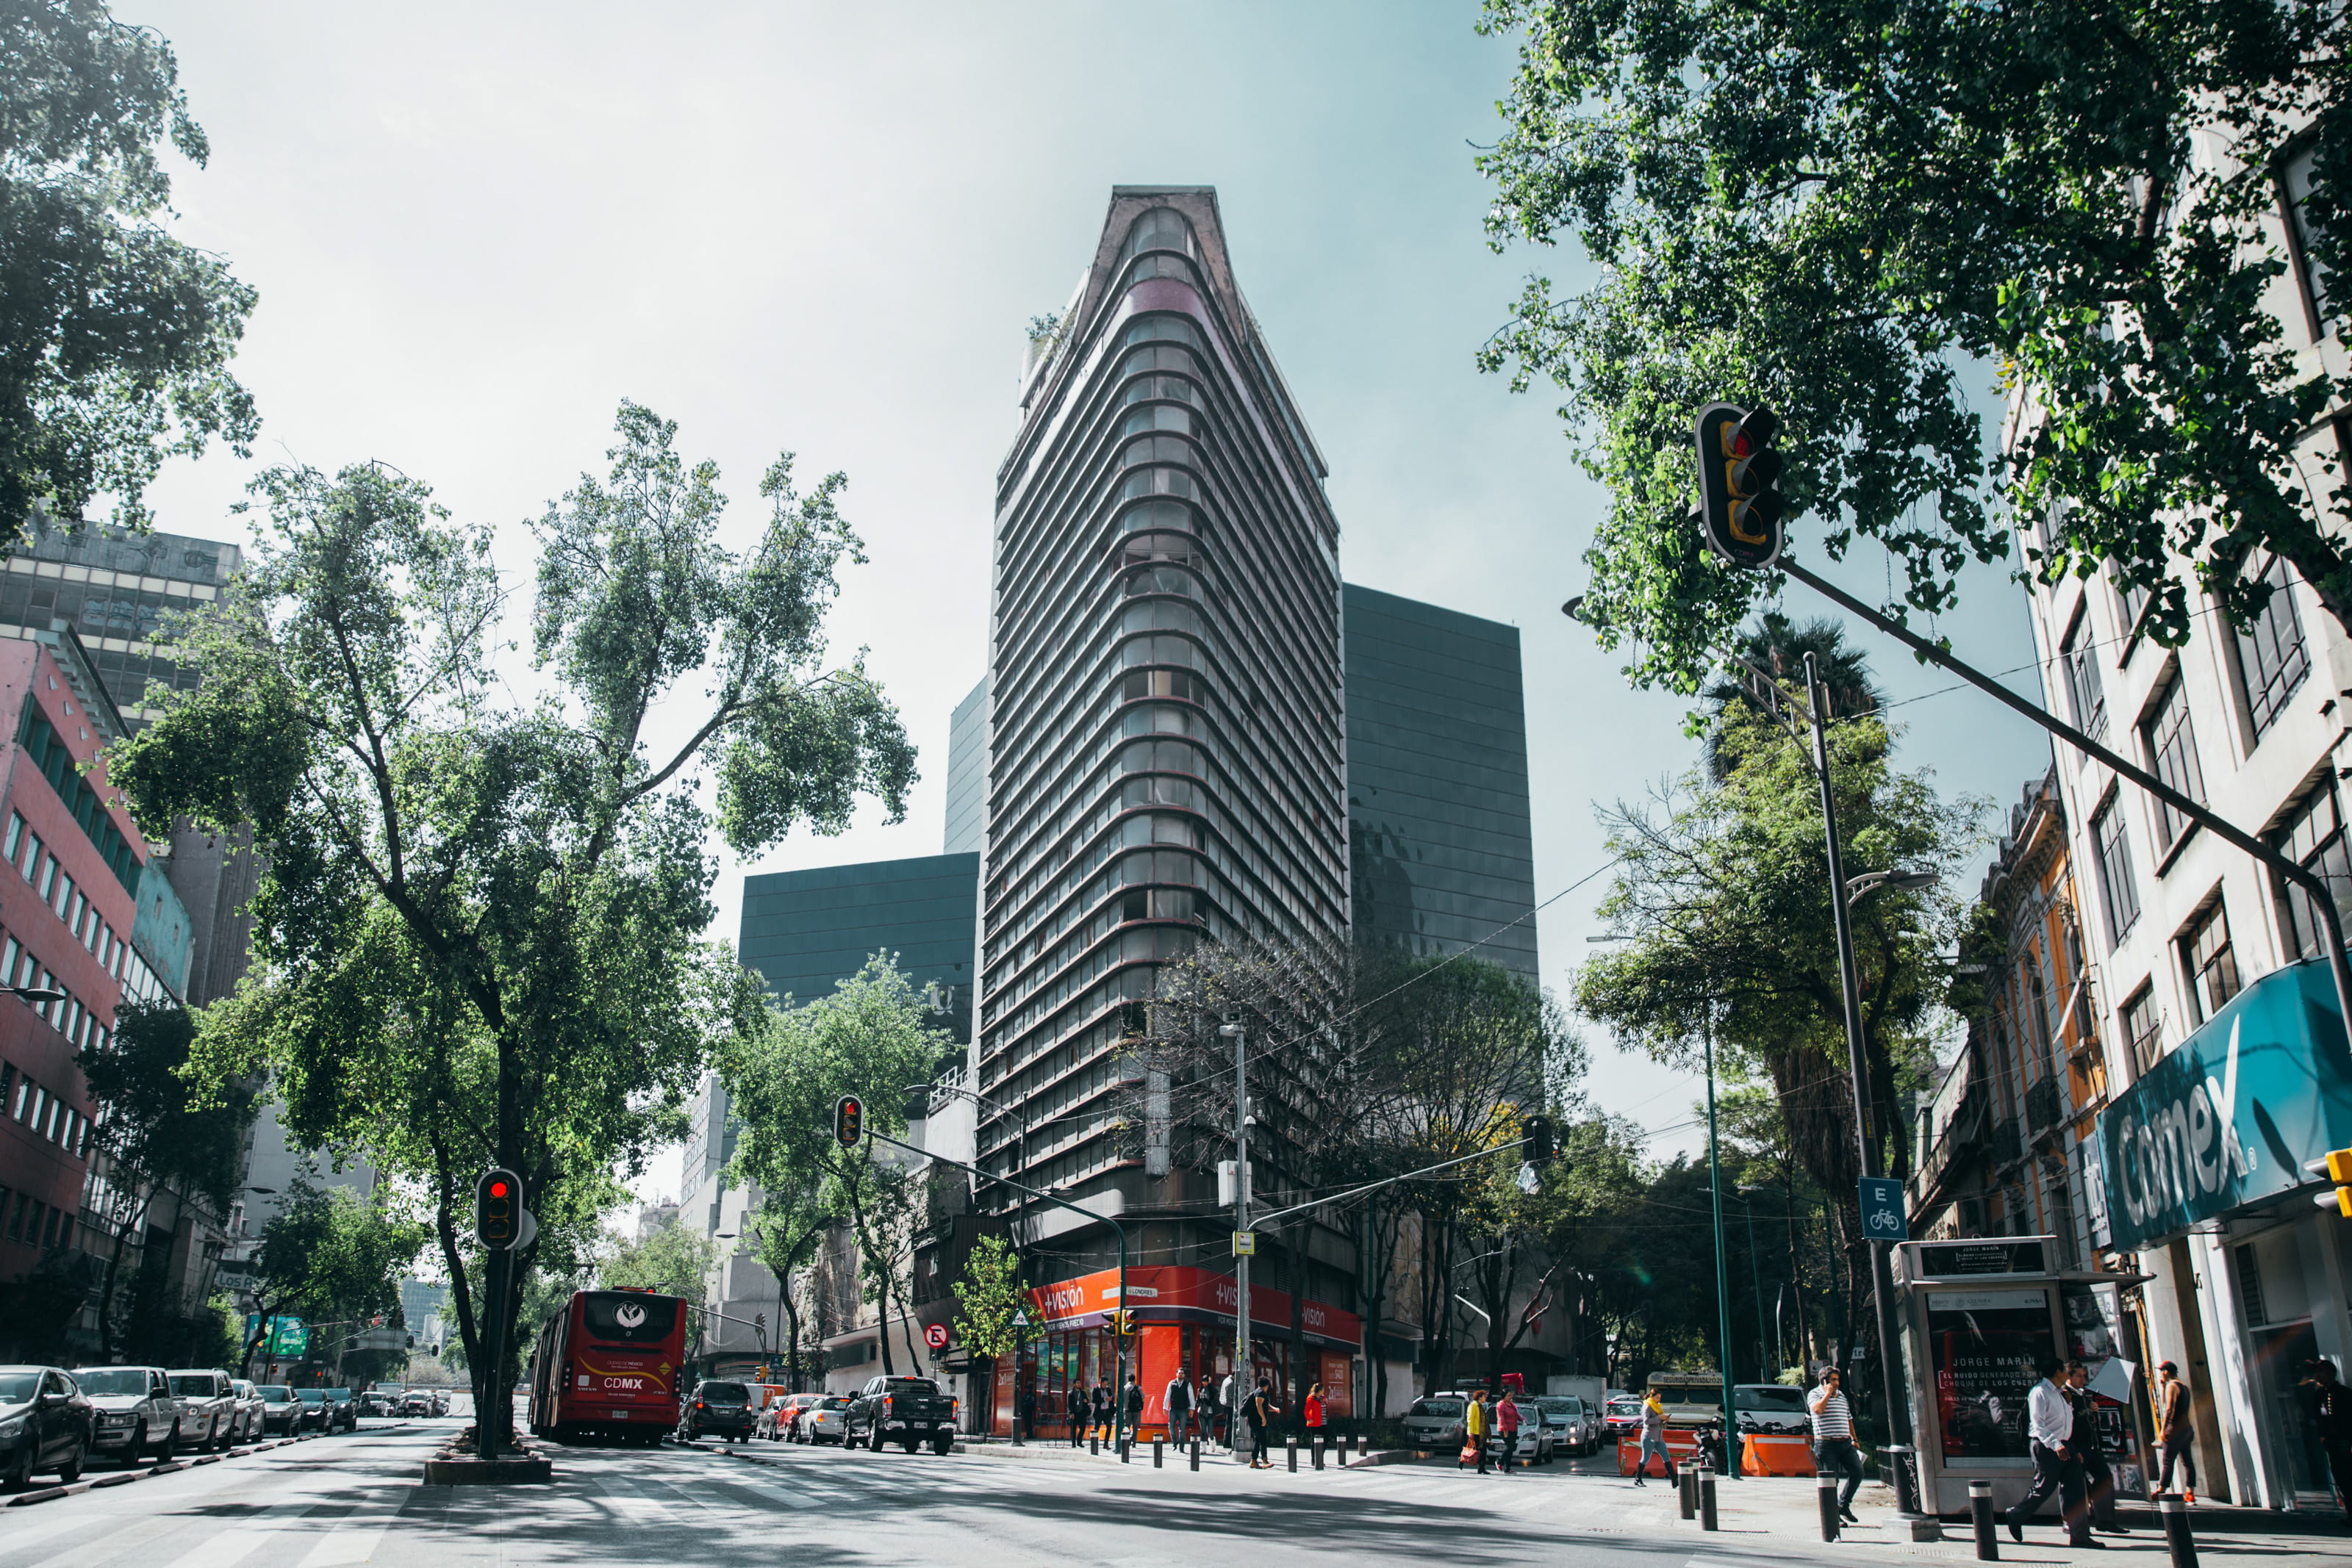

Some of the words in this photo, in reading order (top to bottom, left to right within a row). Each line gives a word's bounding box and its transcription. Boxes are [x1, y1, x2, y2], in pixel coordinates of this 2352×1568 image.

[1875, 1187, 1887, 1201] E
[1953, 1358, 1990, 1367] JORGE
[604, 1377, 643, 1389] CDMX
